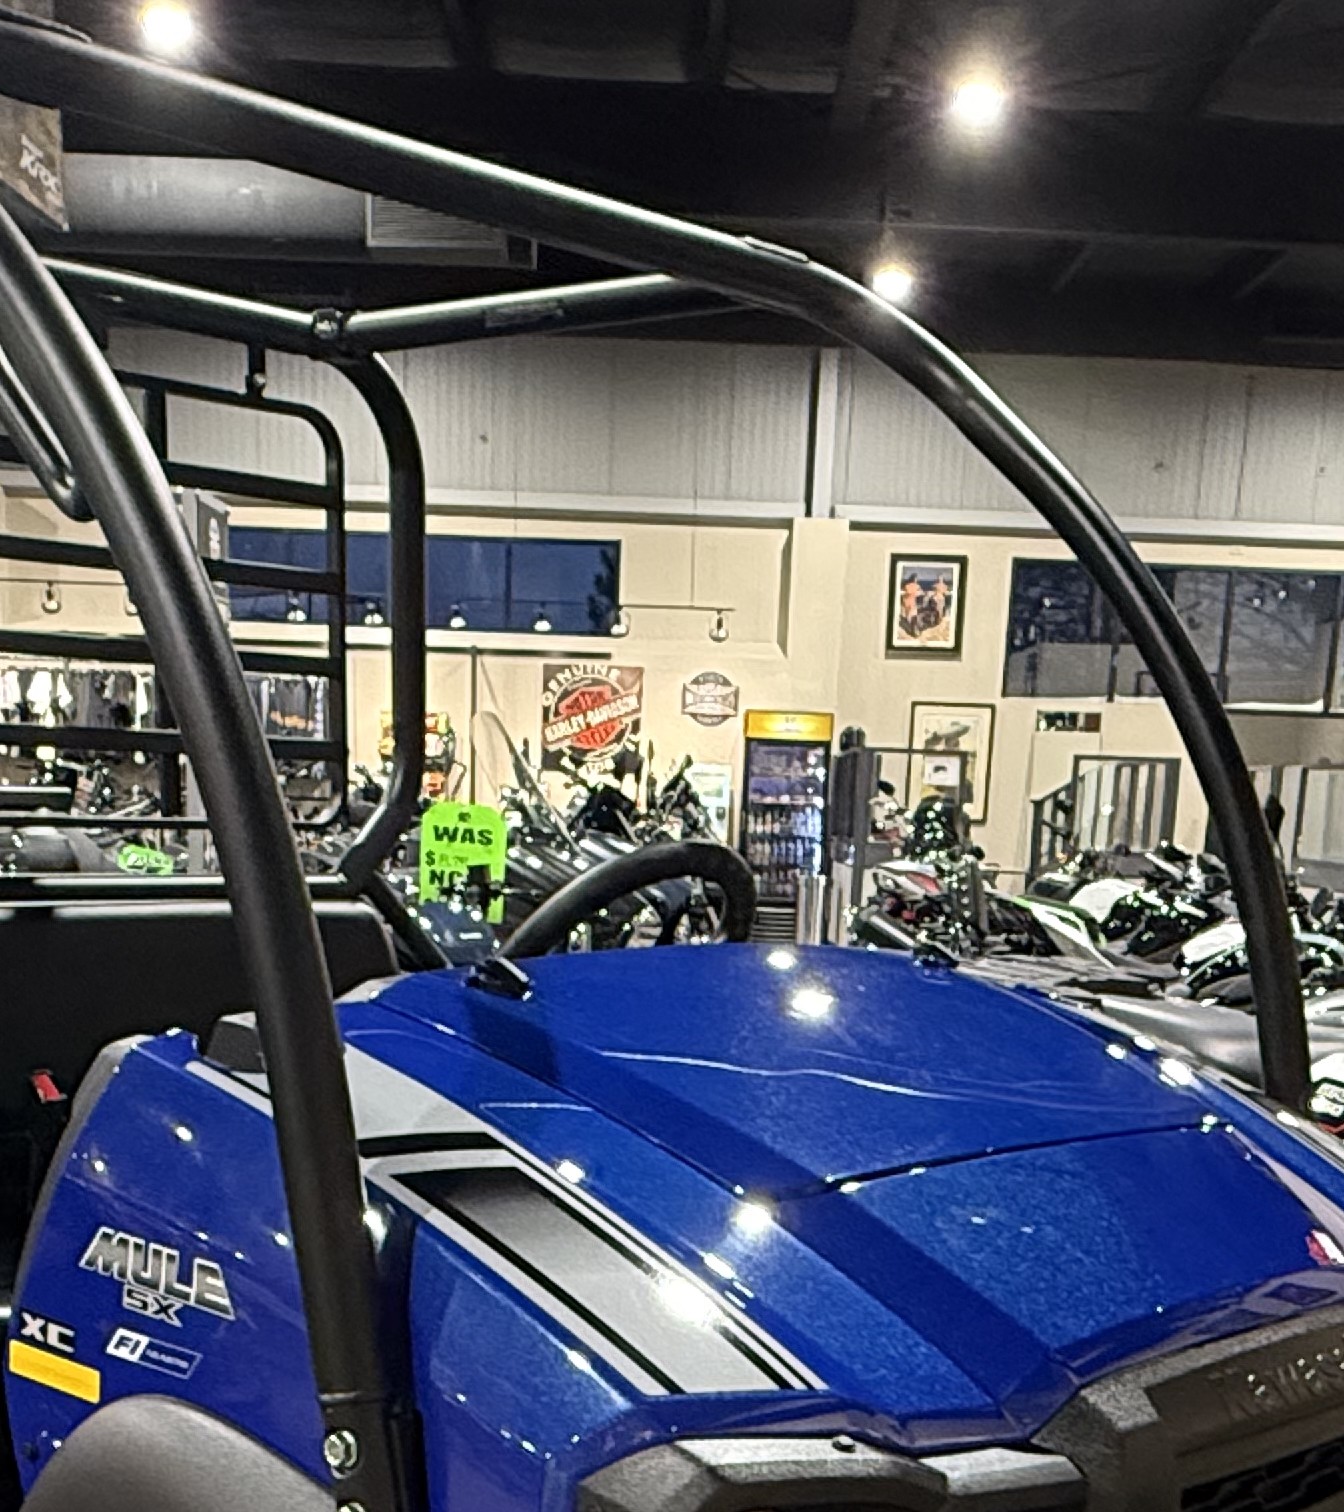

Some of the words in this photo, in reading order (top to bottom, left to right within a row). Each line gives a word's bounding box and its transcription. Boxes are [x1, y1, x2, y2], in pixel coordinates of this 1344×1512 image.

[433, 824, 494, 846] WAS
[78, 1226, 236, 1321] MULE
[122, 1285, 183, 1328] SX
[20, 1312, 75, 1354] XC
[113, 1336, 142, 1356] FI
